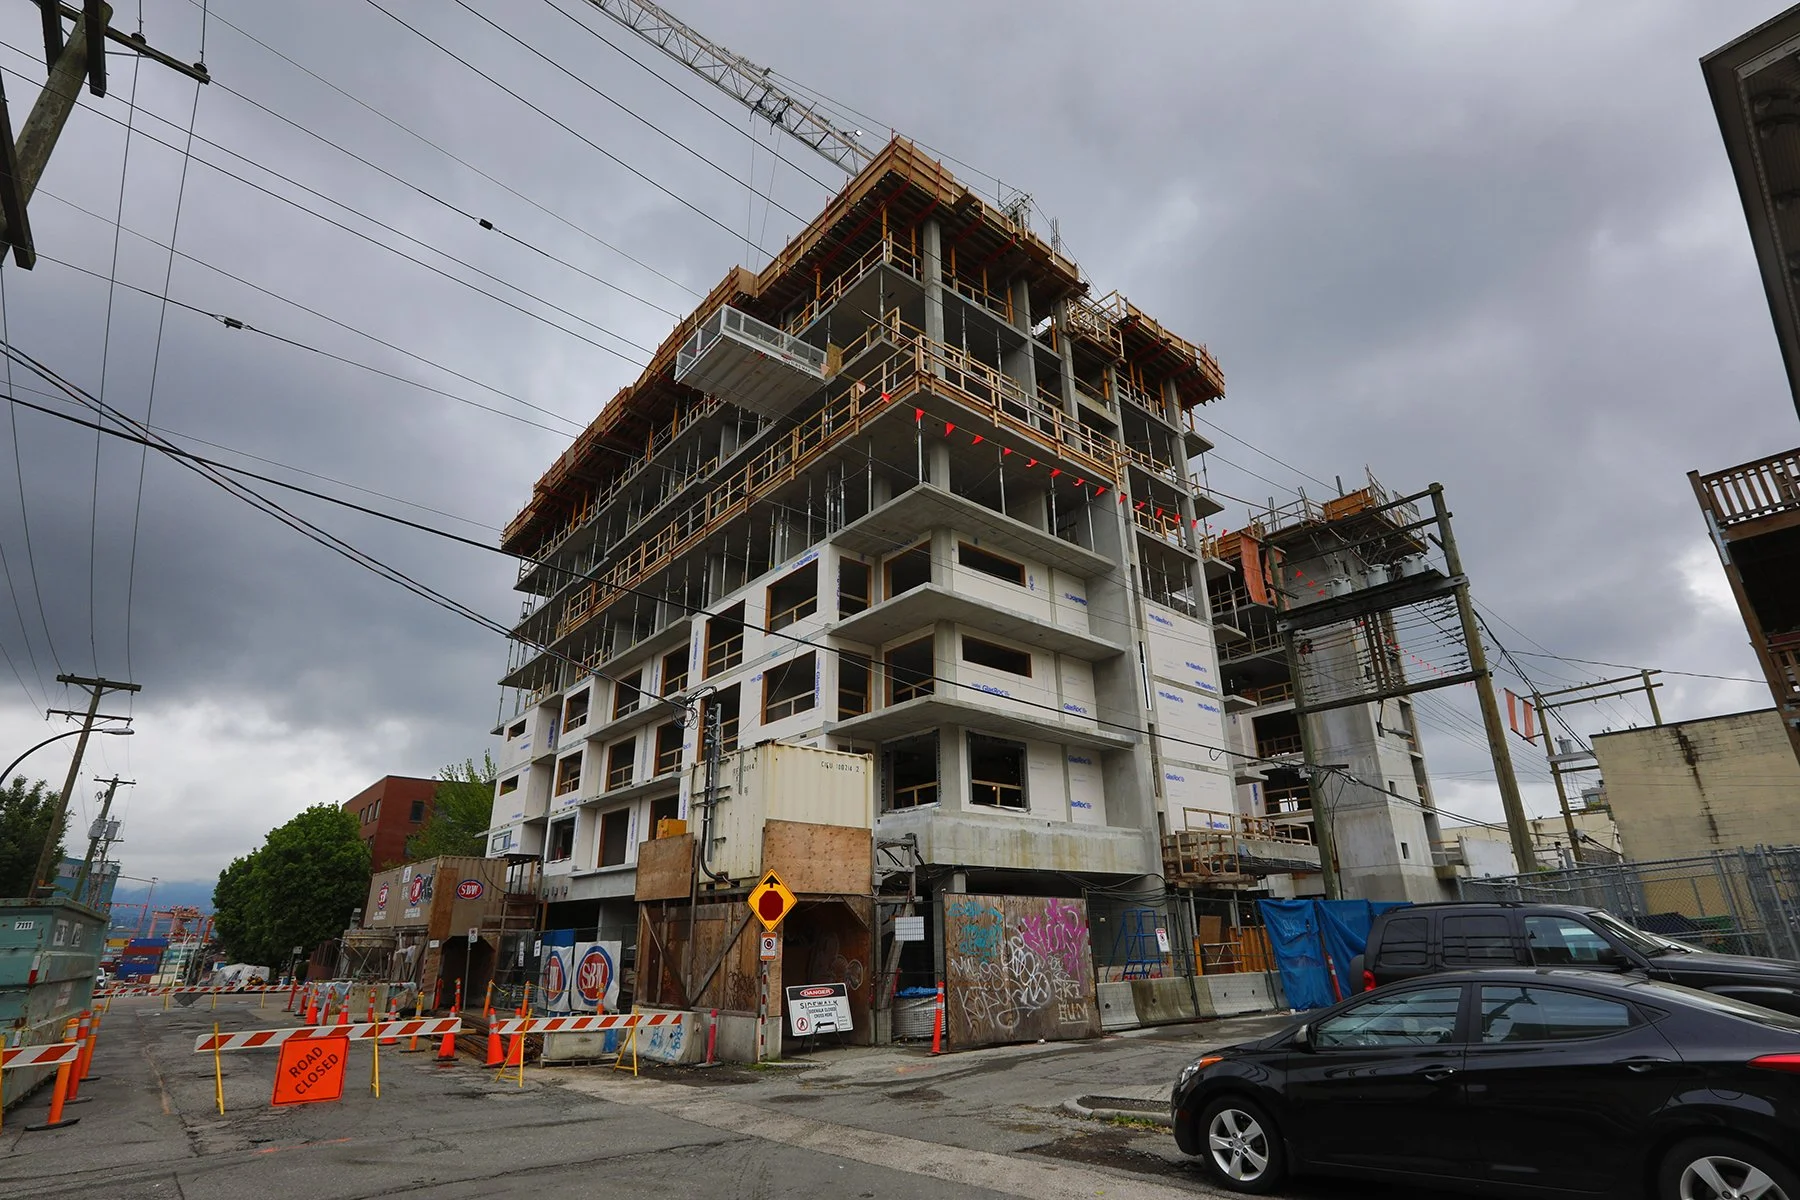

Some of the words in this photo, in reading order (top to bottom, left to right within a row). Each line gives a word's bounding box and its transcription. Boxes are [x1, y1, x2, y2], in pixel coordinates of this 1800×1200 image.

[461, 885, 478, 895] SBW
[581, 962, 605, 990] SBW
[289, 1047, 322, 1078] ROAD
[295, 1053, 339, 1095] CLOSED
